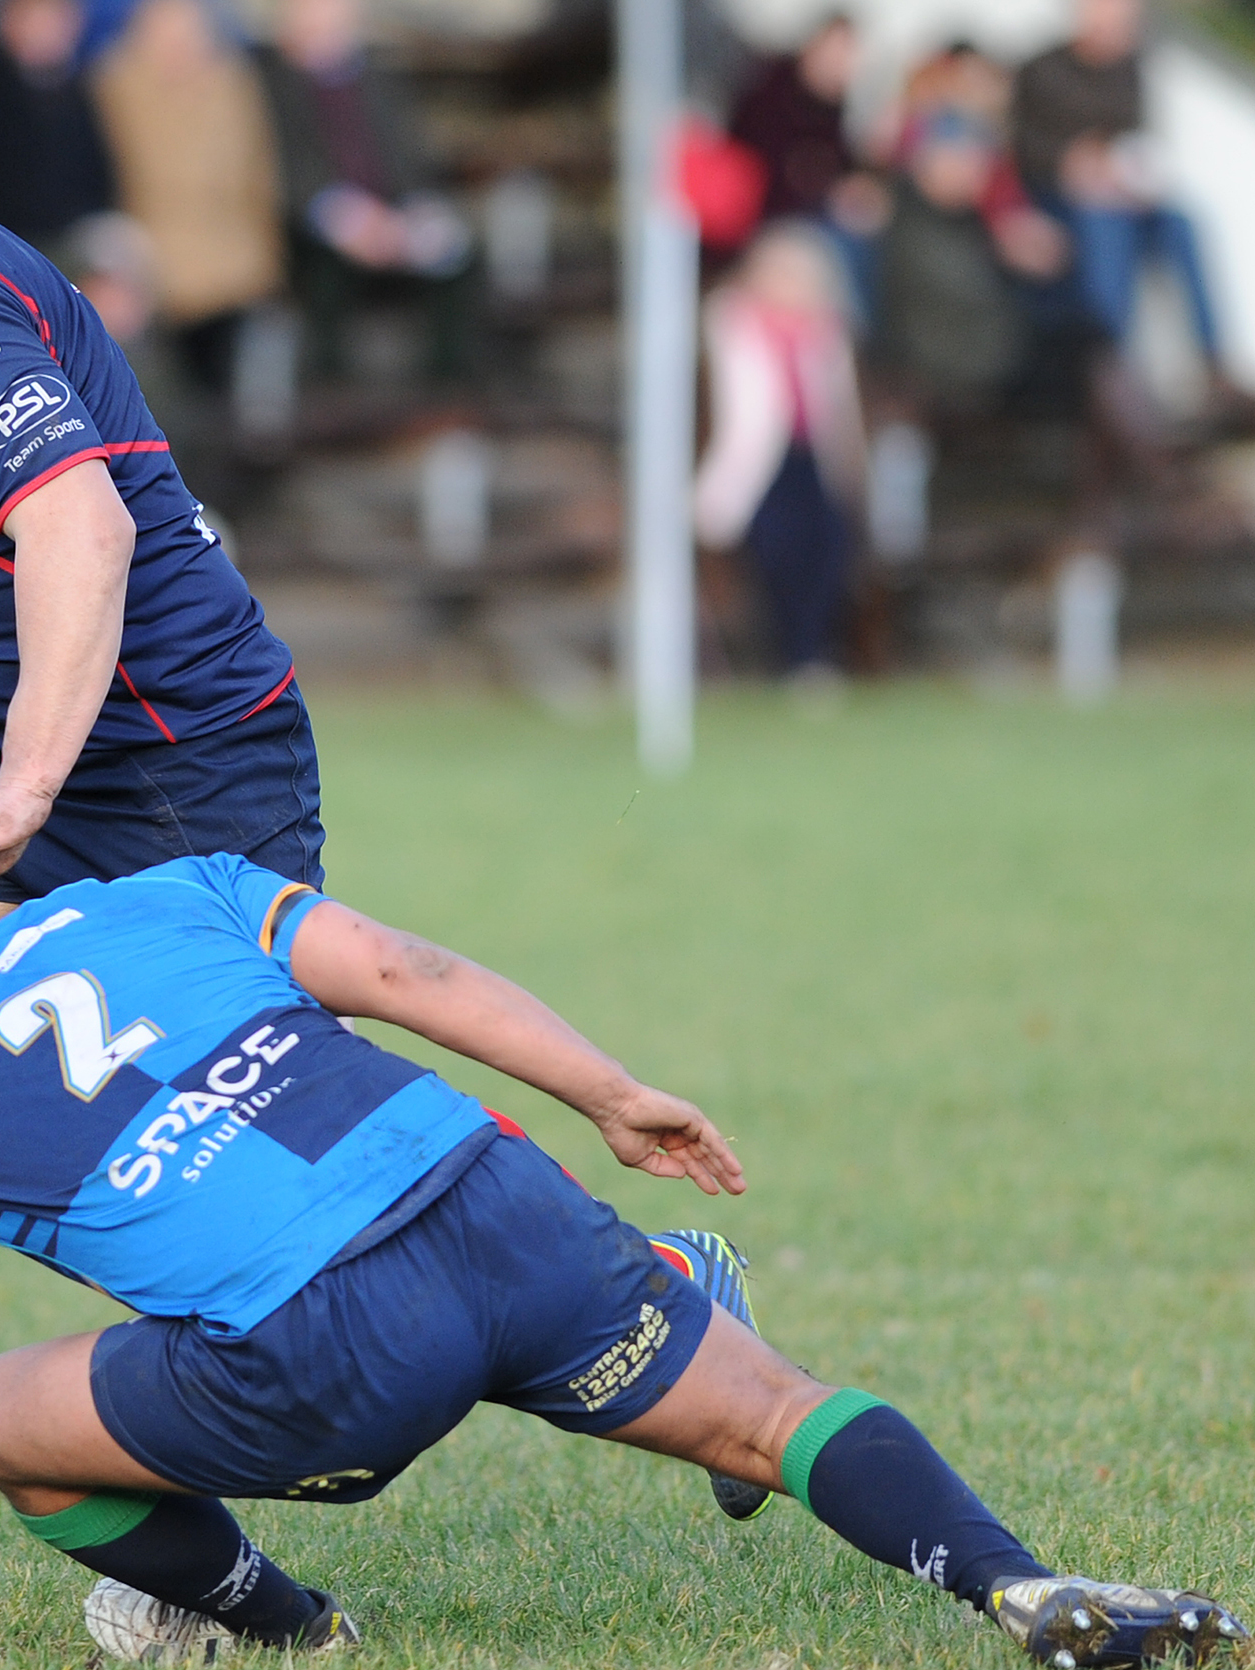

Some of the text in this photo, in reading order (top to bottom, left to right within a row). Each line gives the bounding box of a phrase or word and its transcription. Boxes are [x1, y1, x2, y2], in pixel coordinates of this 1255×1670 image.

[4, 418, 85, 473] Team Sports
[108, 1025, 300, 1199] SPACE
[569, 1340, 629, 1390] CENTRAL
[586, 1385, 621, 1412] Faster
[620, 1348, 654, 1388] Greener
[587, 1359, 628, 1396] 229
